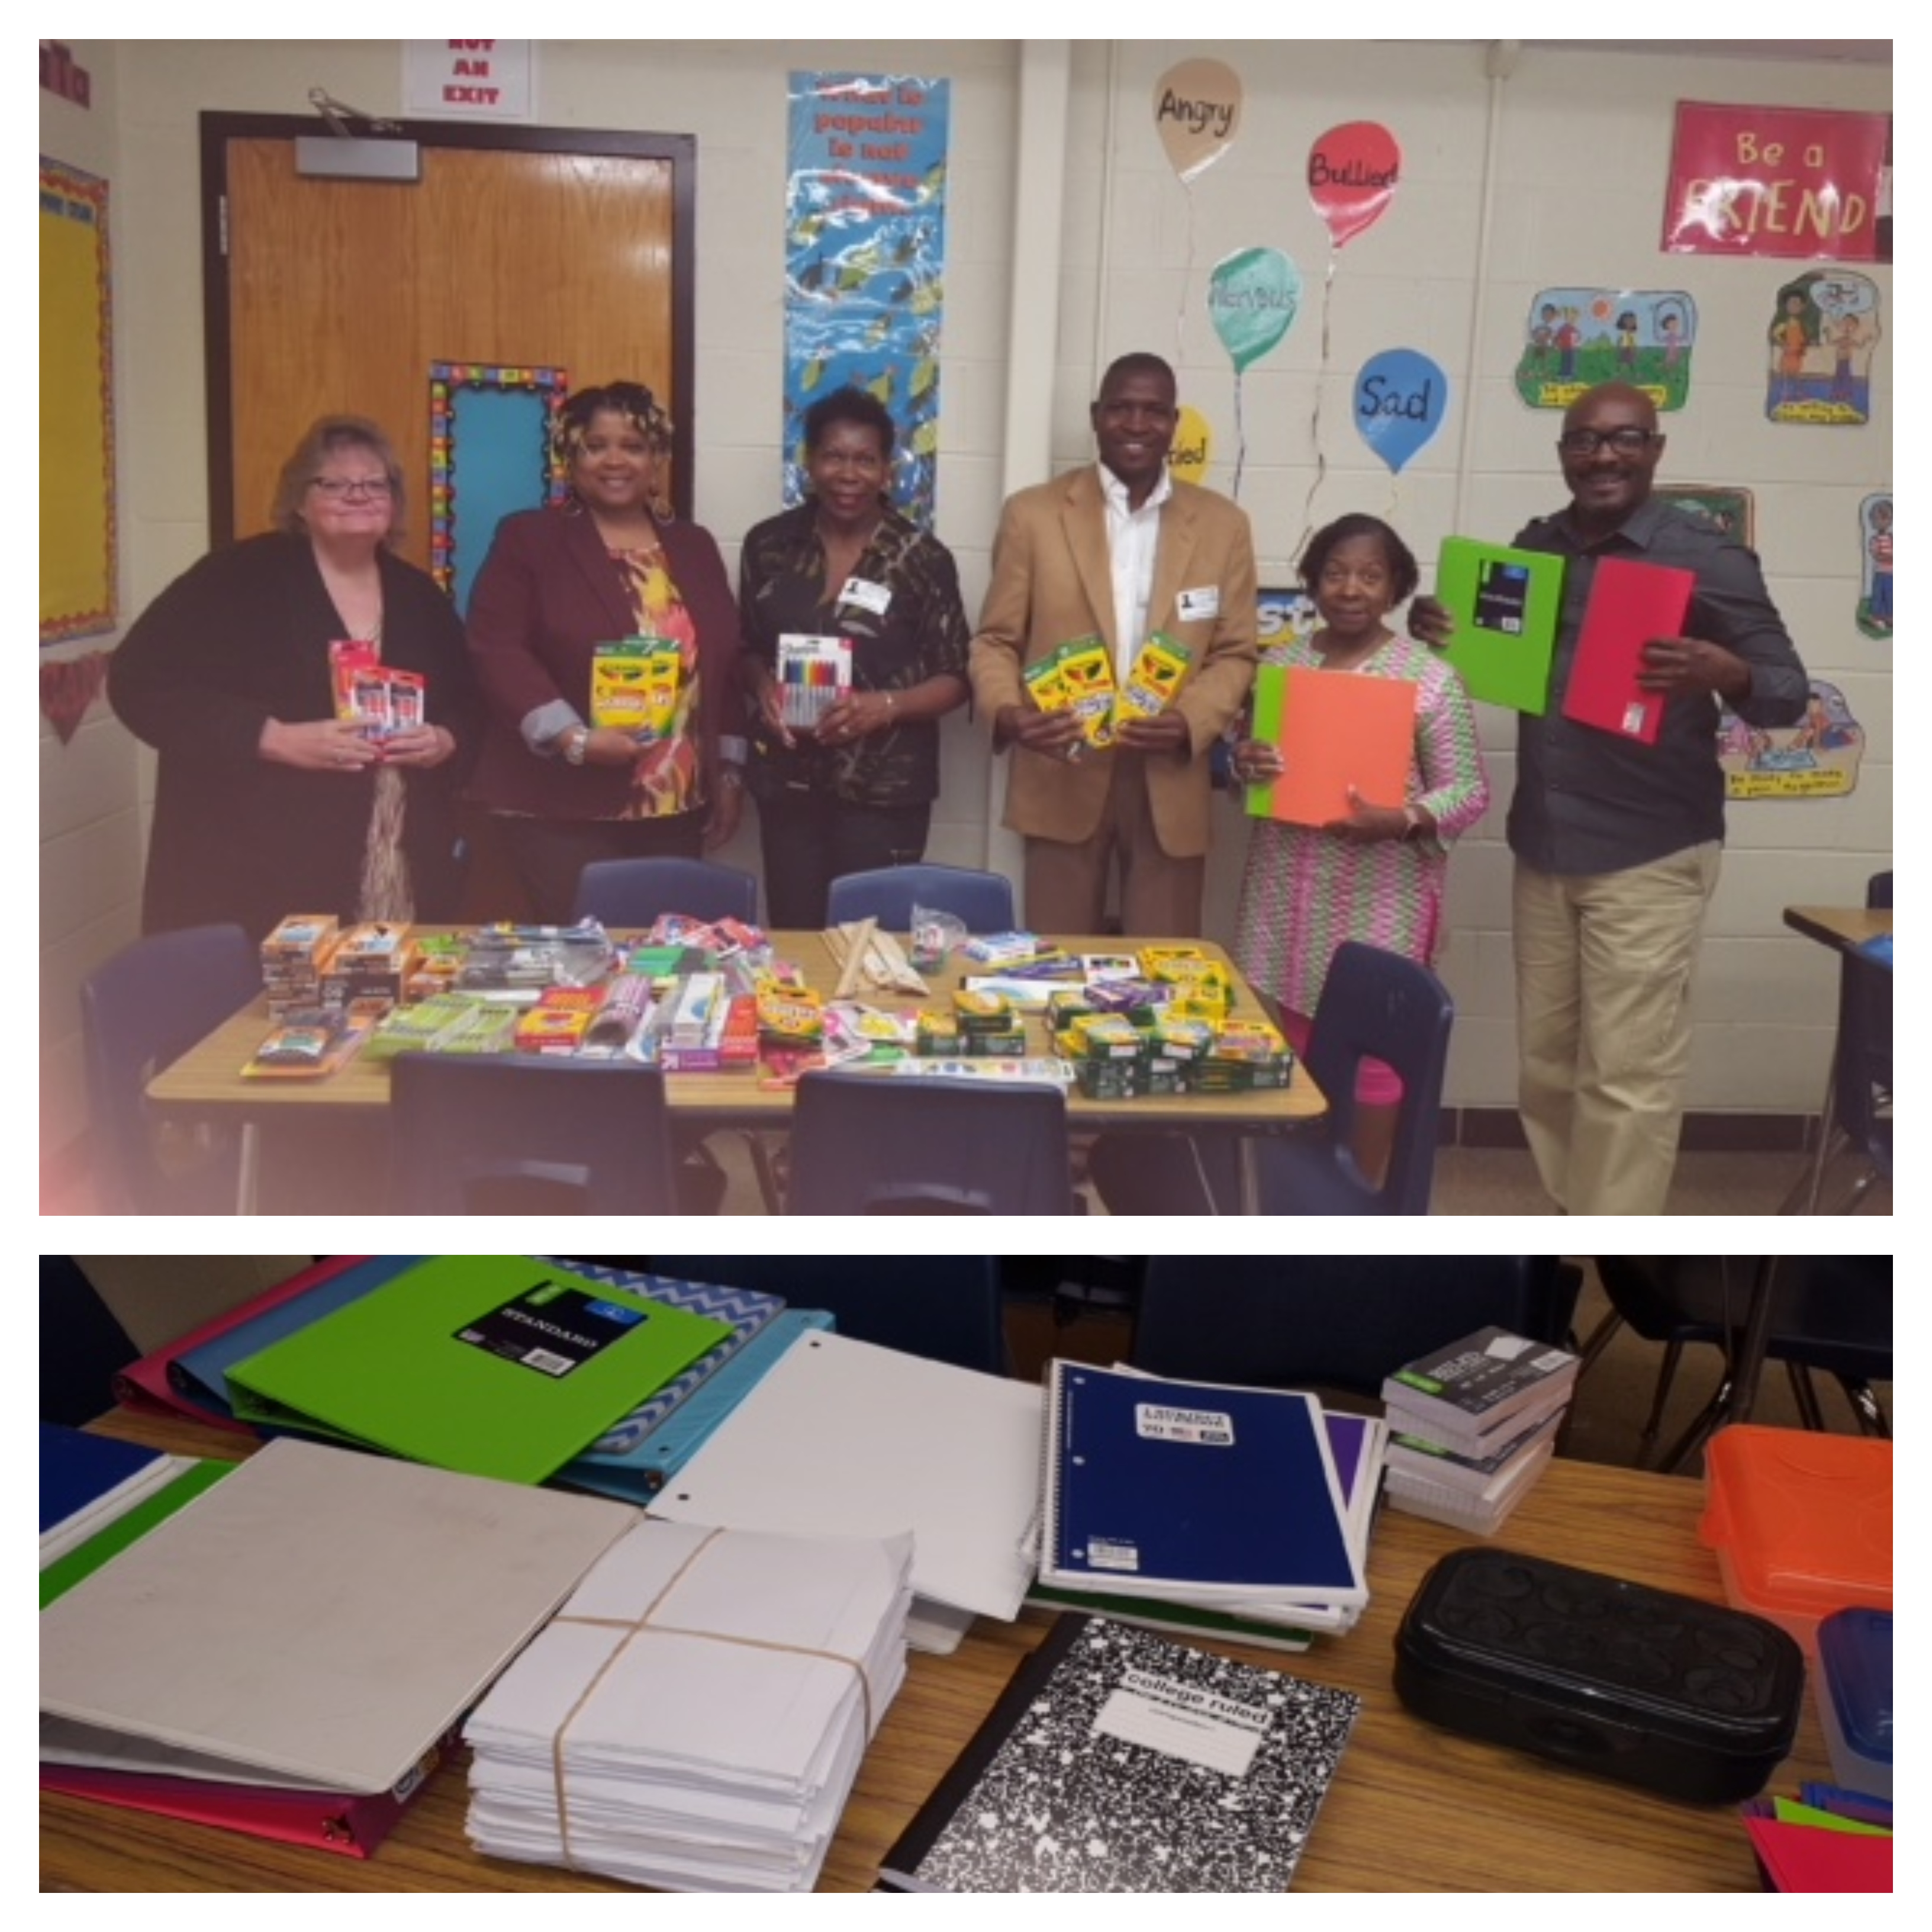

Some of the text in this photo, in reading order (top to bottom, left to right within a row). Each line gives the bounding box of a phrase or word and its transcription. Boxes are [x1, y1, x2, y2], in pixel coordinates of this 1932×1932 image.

[452, 59, 490, 78] AN
[442, 85, 499, 105] EXIT
[814, 111, 925, 136] popular
[1158, 88, 1235, 138] Angry
[829, 138, 910, 161] is not
[1737, 132, 1824, 168] Be a
[1360, 375, 1432, 422] Sad
[1167, 437, 1206, 465] ried
